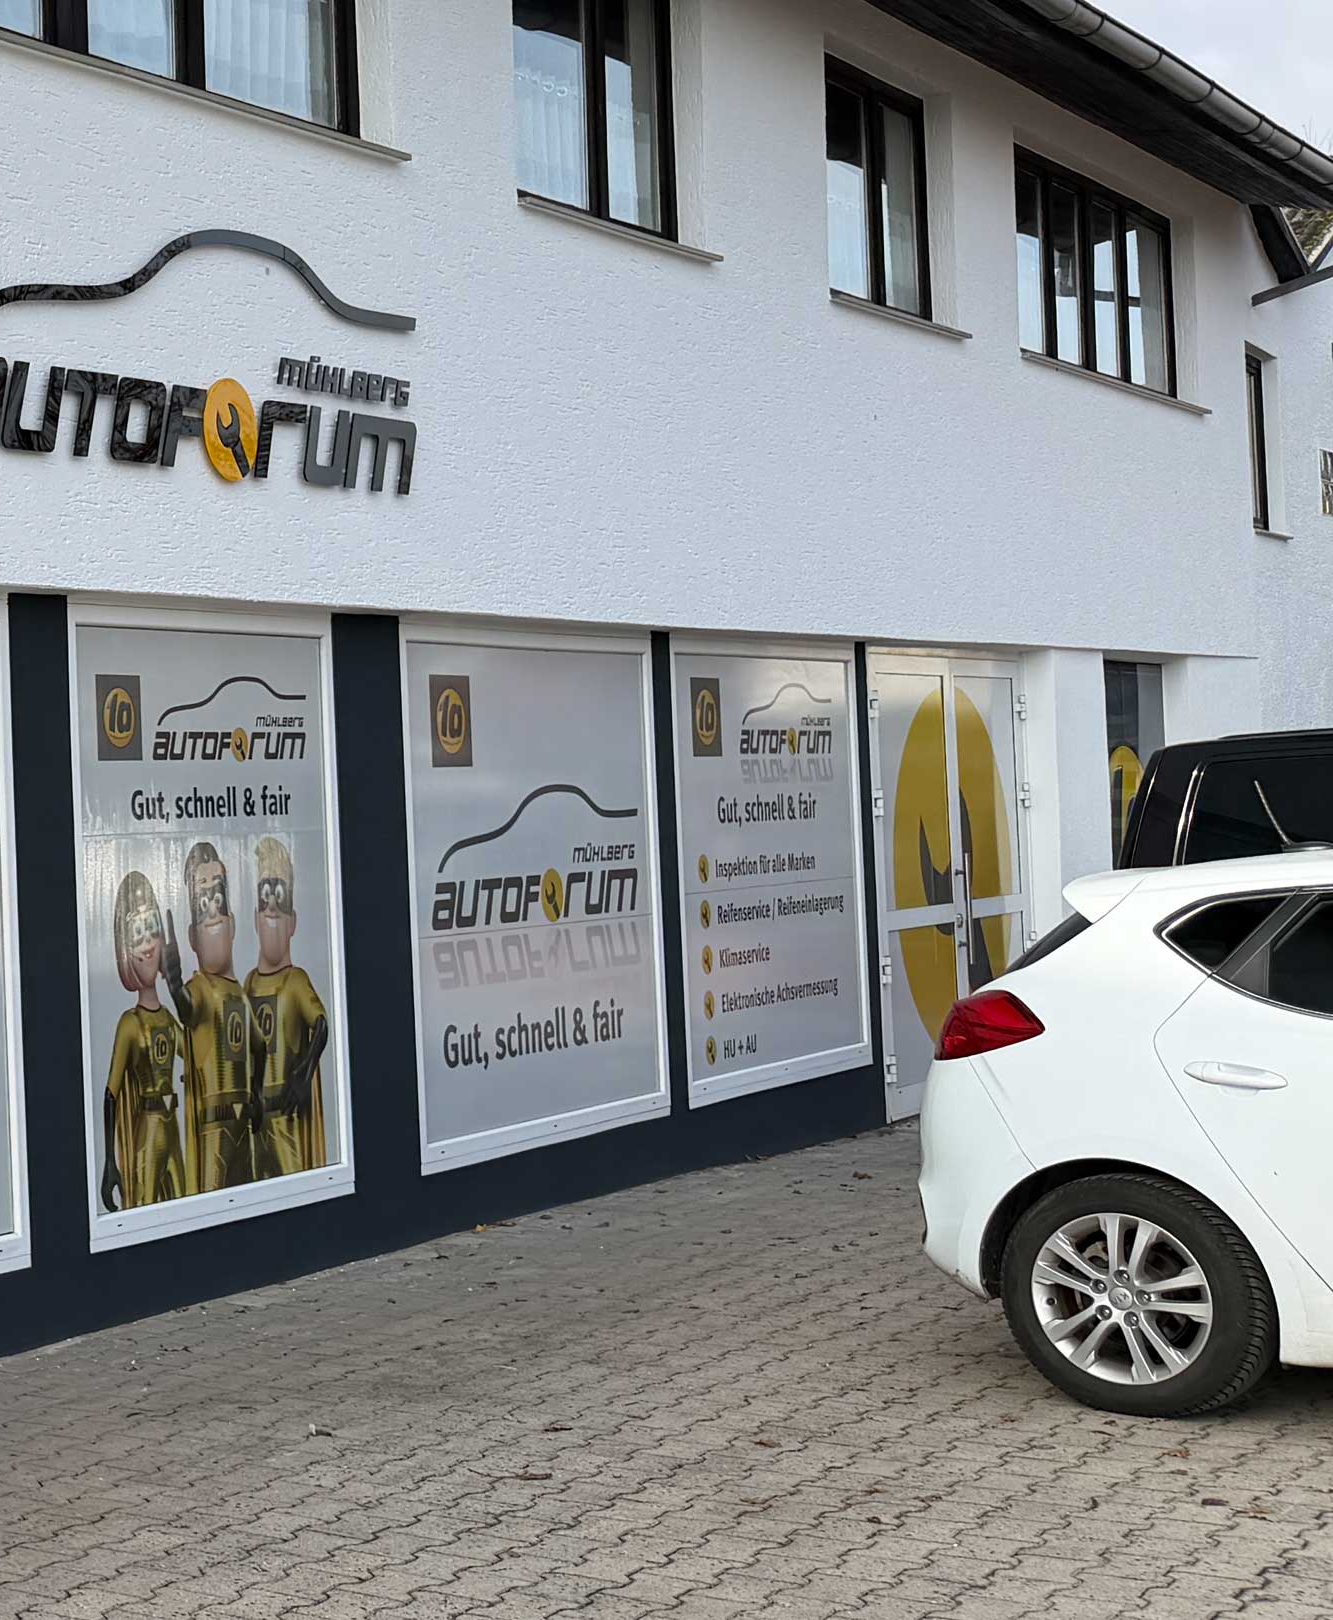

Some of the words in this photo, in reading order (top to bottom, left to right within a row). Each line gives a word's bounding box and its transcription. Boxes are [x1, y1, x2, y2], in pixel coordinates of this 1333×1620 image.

[132, 790, 169, 823] Gut,
[175, 786, 236, 818] schnell
[243, 788, 256, 817] &
[261, 785, 291, 816] fair
[717, 796, 742, 827] Gut,
[745, 793, 784, 823] schnell
[787, 794, 797, 820] &
[799, 792, 816, 819] fair
[716, 857, 758, 881] Inspektion
[759, 855, 770, 875] für
[772, 854, 785, 873] alle
[788, 852, 815, 871] Marken
[717, 900, 771, 924] Reifenservice
[778, 893, 844, 916] Reifeneinlagerung
[720, 943, 770, 968] Klimaservice
[722, 987, 775, 1013] Elektronische
[776, 977, 838, 1002] Achsvermessung
[444, 1024, 488, 1070] Gut,
[495, 1006, 568, 1060] schnell
[573, 1008, 588, 1047] &
[593, 998, 623, 1043] fair
[724, 1038, 736, 1059] HU
[746, 1034, 757, 1053] AU
